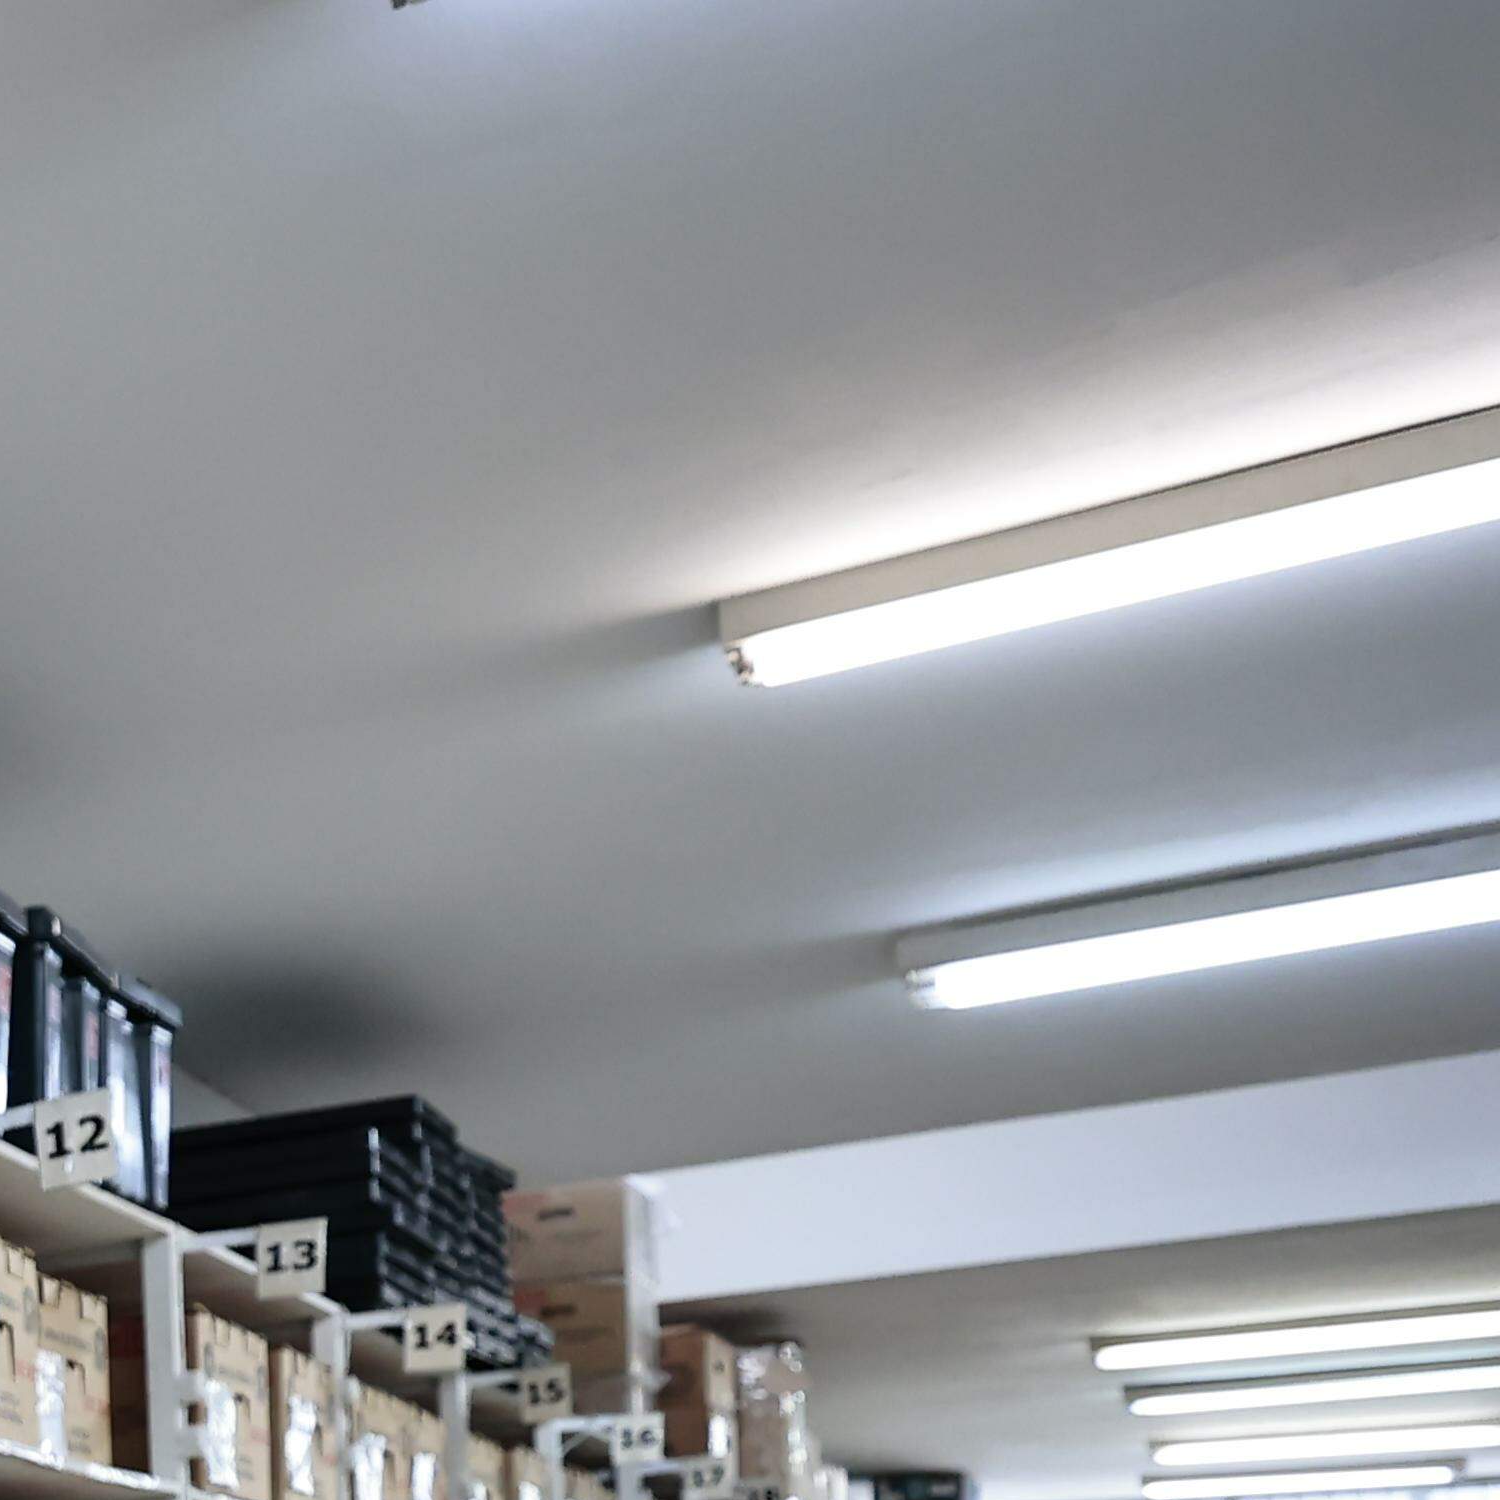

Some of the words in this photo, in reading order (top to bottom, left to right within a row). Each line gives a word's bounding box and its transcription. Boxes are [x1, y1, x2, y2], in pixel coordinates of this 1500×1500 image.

[45, 1114, 110, 1160] 12
[266, 1238, 320, 1276] 13
[411, 1322, 459, 1350] 14
[528, 1378, 564, 1406] 15
